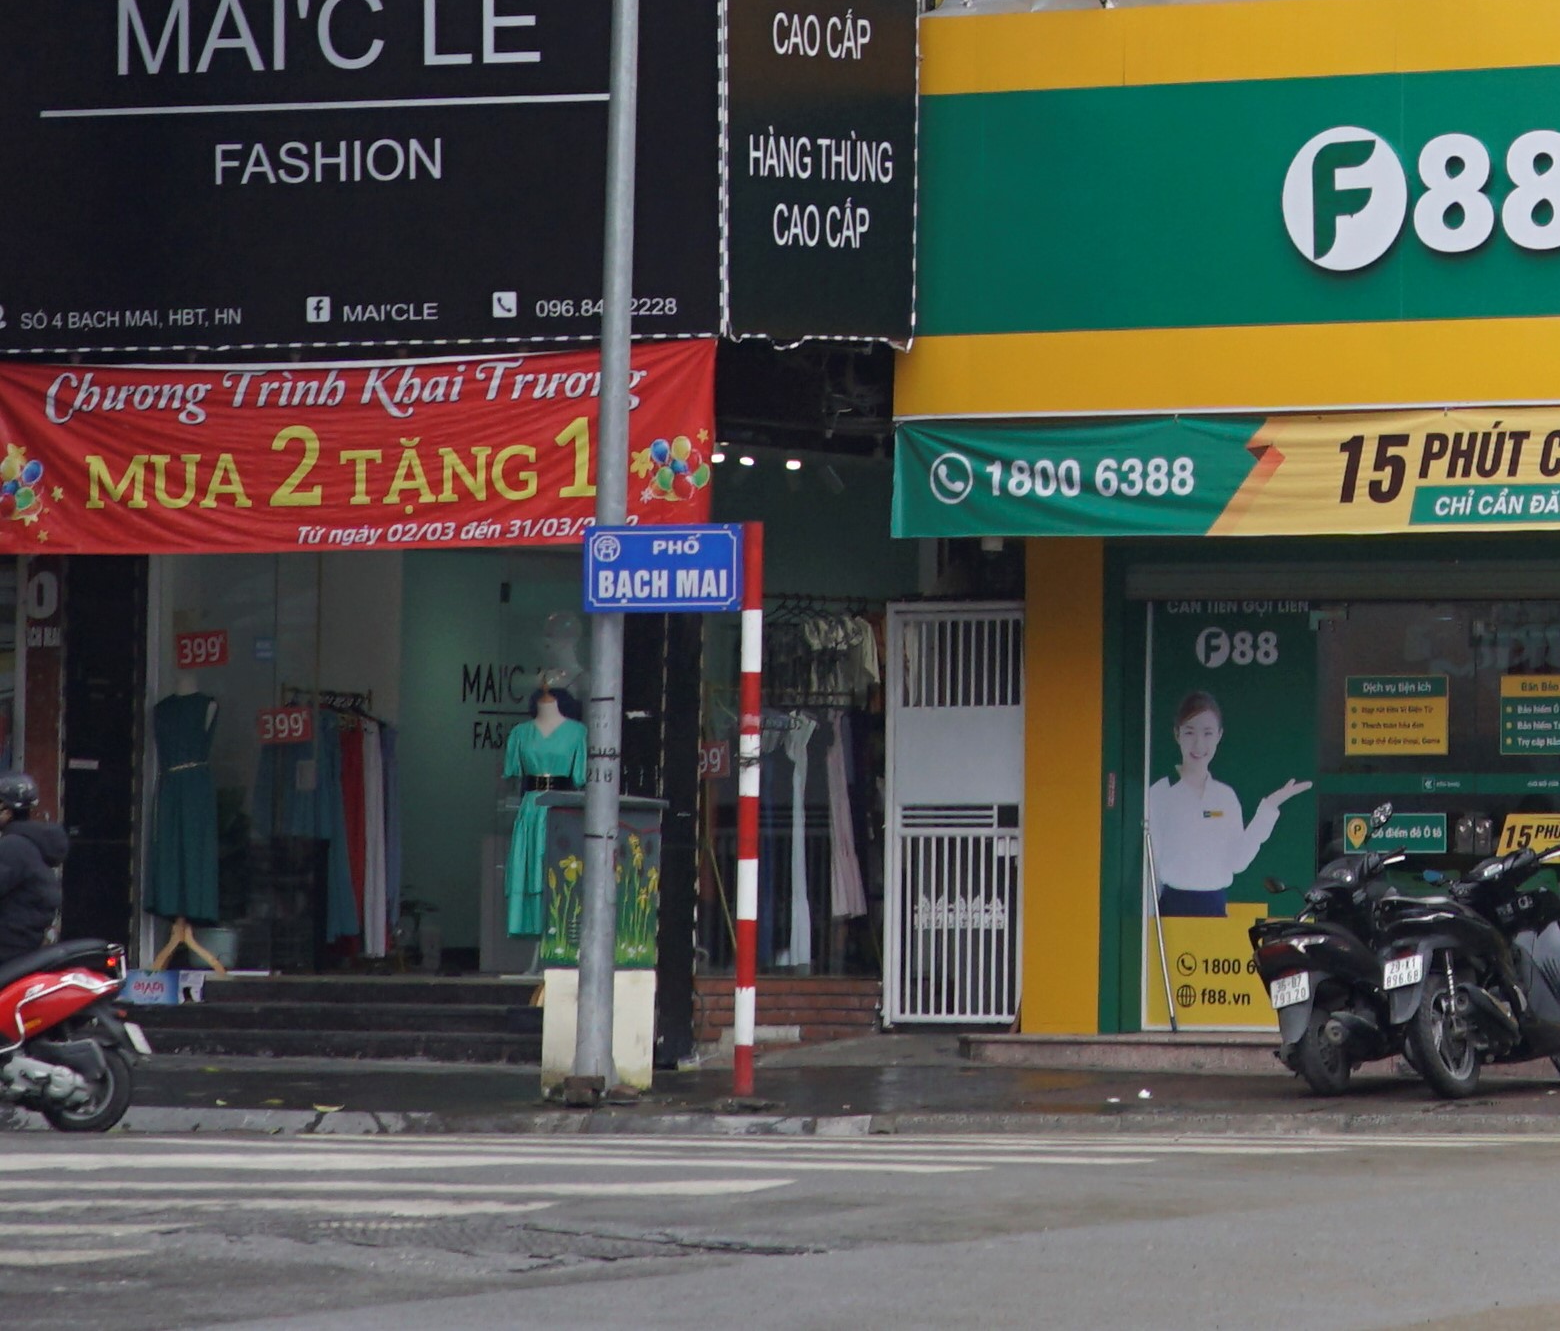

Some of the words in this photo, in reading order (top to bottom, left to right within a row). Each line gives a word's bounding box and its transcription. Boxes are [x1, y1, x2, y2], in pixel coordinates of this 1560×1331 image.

[773, 11, 821, 57] CAO
[826, 8, 872, 60] CẤP
[213, 137, 444, 187] FASHION
[749, 125, 812, 180] HÀNG
[817, 130, 893, 183] THÙNG
[773, 203, 821, 247] CAO
[825, 197, 871, 249] CẤP
[51, 314, 63, 329] 4
[68, 311, 120, 332] BẠCH
[124, 310, 164, 330] MAI,
[168, 308, 210, 329] HBT,
[214, 308, 243, 326] HN
[342, 302, 440, 323] MAI'CLE
[45, 372, 212, 424] Chương
[223, 368, 346, 410] Trình
[361, 365, 463, 418] Khai
[86, 452, 252, 509] MUA
[271, 425, 322, 507] 2
[340, 437, 538, 515] TẶNG
[555, 417, 598, 498] 1
[986, 459, 1081, 497] 1800
[1095, 457, 1195, 497] 6388
[1339, 434, 1410, 504] 15
[1418, 421, 1531, 479] PHÚT
[1435, 491, 1474, 517] CHỈ
[1478, 488, 1526, 516] CẦN
[298, 525, 326, 546] Từ
[329, 524, 382, 547] ngày
[387, 521, 455, 542] 02/03
[460, 518, 501, 541] đến
[652, 534, 699, 556] PHỐ
[598, 570, 668, 604] BẠCH
[675, 568, 728, 598] MAI
[1196, 626, 1279, 668] F88
[462, 664, 525, 703] MAI'C
[1423, 825, 1432, 838] Ô
[1506, 825, 1534, 849] 15
[1202, 959, 1241, 975] 1800
[1201, 988, 1251, 1007] f88.vn
